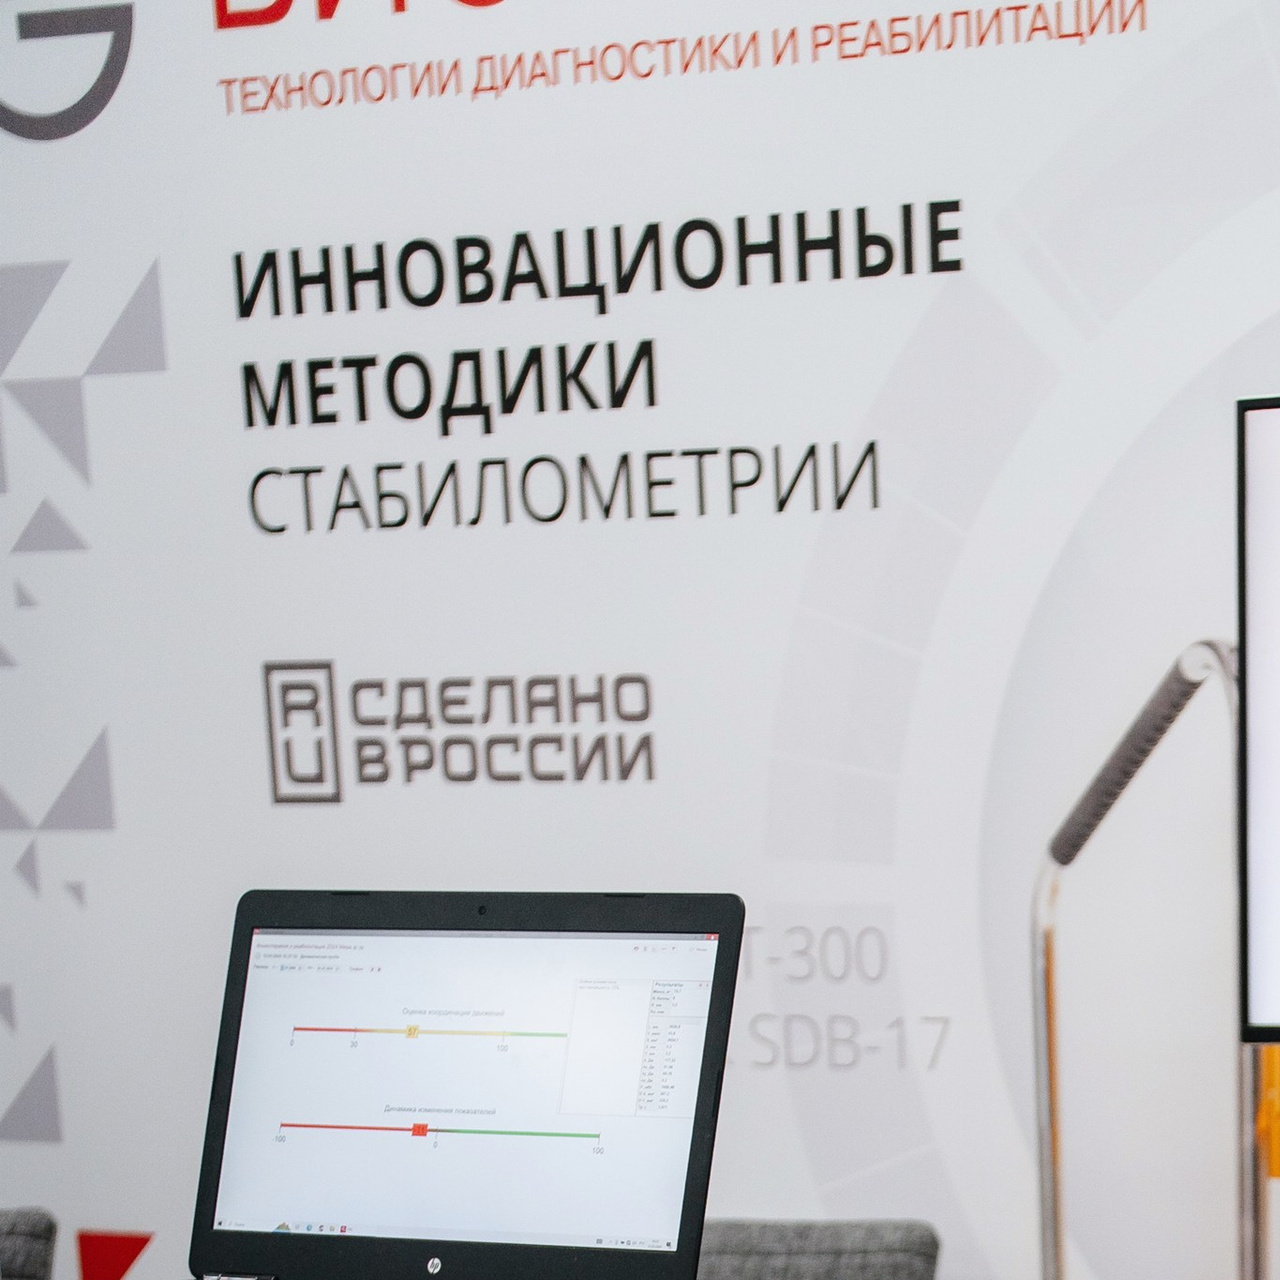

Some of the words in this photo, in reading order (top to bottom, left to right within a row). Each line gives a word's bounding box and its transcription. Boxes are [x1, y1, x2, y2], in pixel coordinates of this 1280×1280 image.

[217, 61, 463, 116] ТЕХНОЛОГИИ
[469, 28, 760, 101] ДИАГНОСТИКИ
[772, 27, 799, 67] И
[811, 0, 1147, 62] РЕАБИЛИТАЦИИ
[232, 199, 966, 319] ИННОВАЦИОННЫЕ
[240, 338, 660, 436] МЕТОДИКИ
[249, 439, 882, 536] СТАБИЛОМЕТРИИ
[350, 673, 652, 730] СДЕЛАНО
[748, 1012, 951, 1071] SDB-17
